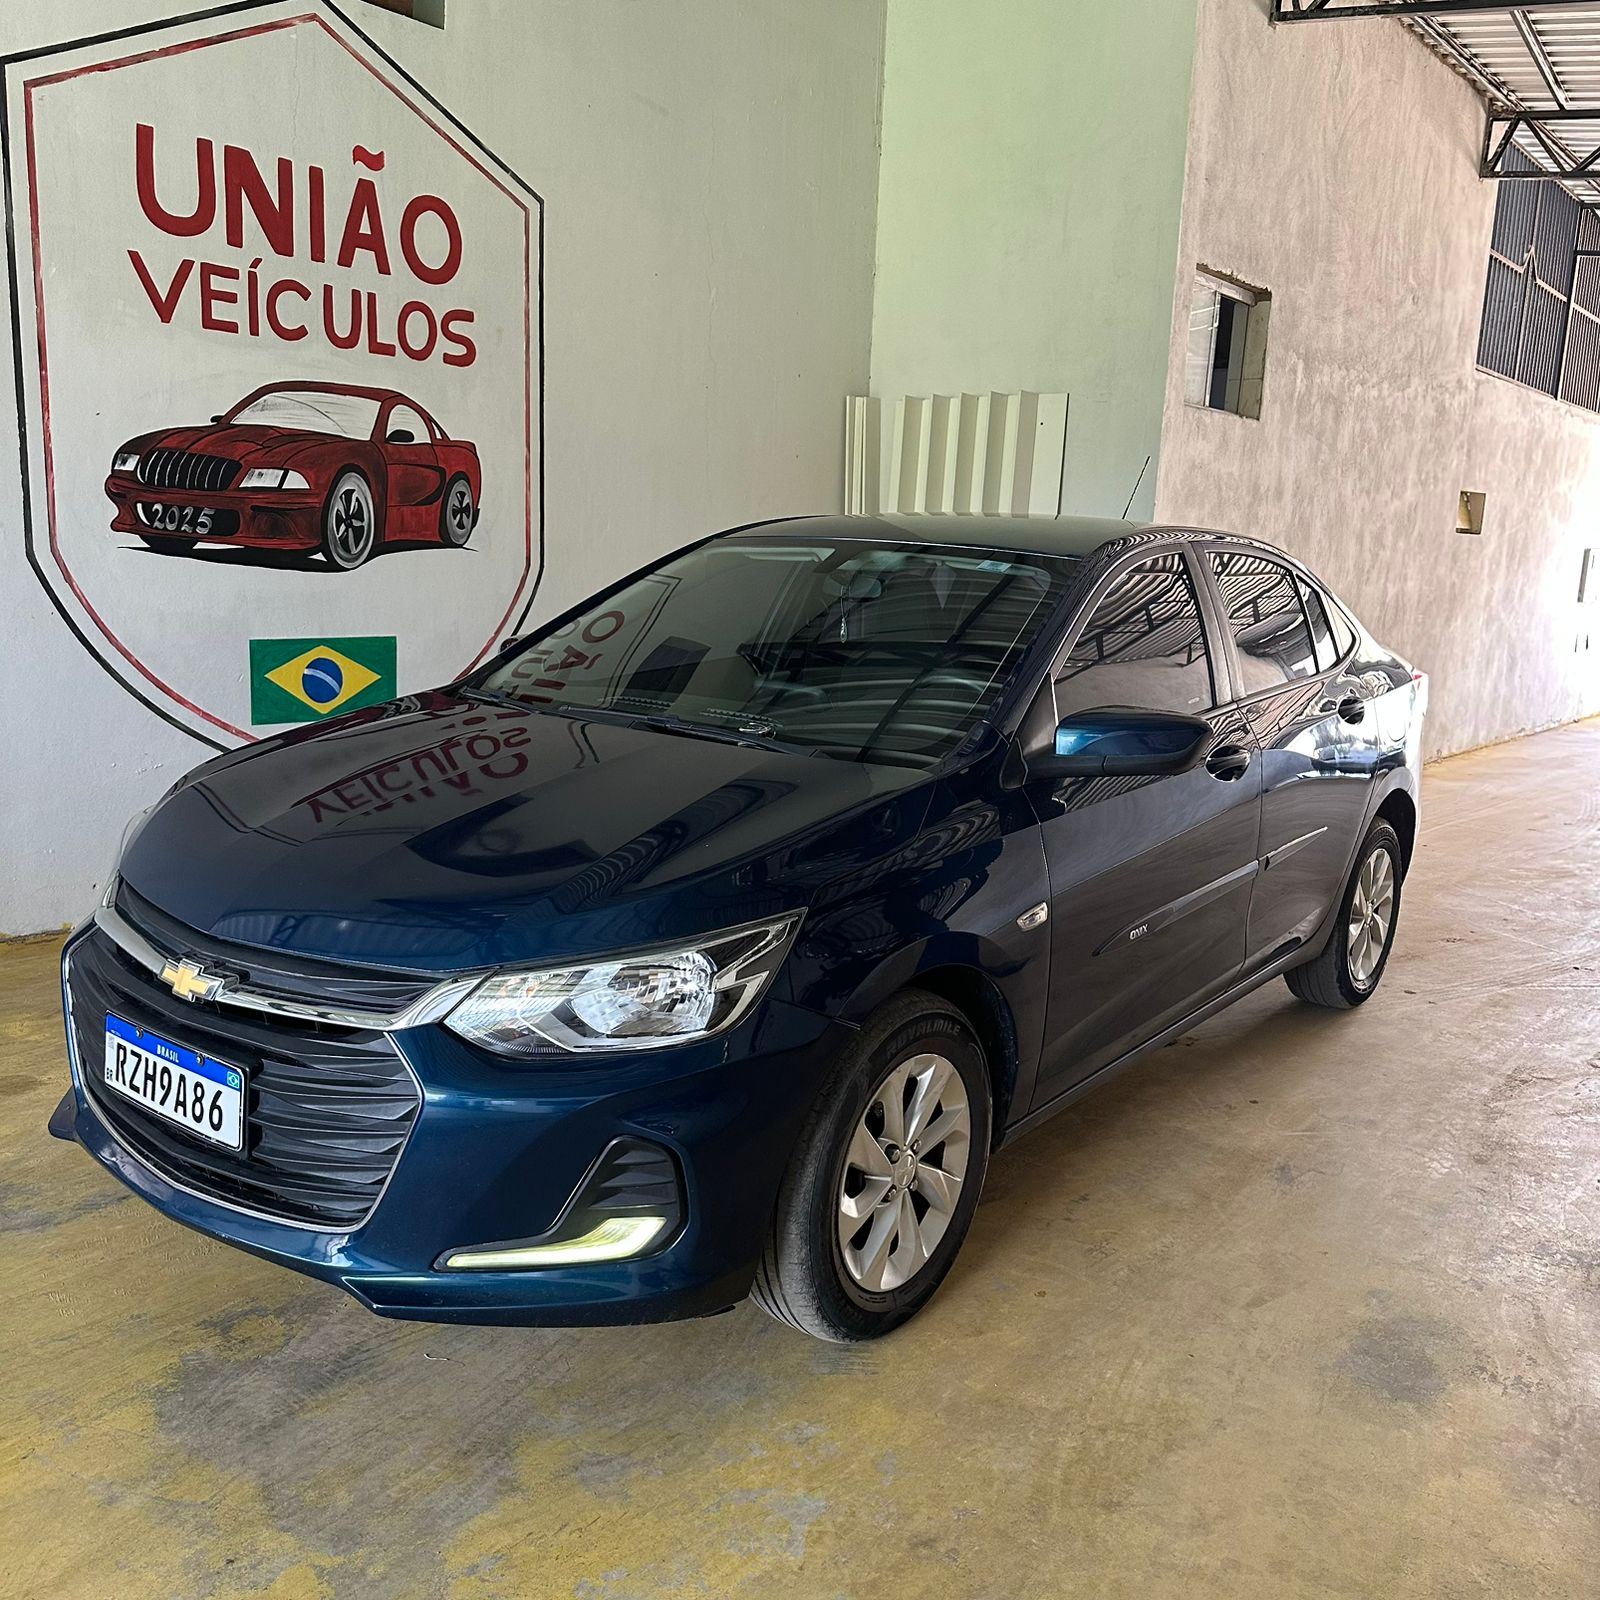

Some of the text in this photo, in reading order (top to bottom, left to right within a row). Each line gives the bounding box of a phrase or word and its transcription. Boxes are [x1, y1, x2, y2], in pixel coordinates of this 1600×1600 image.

[136, 124, 463, 285] UNIÃO
[127, 249, 477, 368] VEÍCULOS
[151, 502, 216, 534] 2025
[115, 1042, 223, 1132] RZH9A86
[156, 1043, 180, 1063] BRASIL
